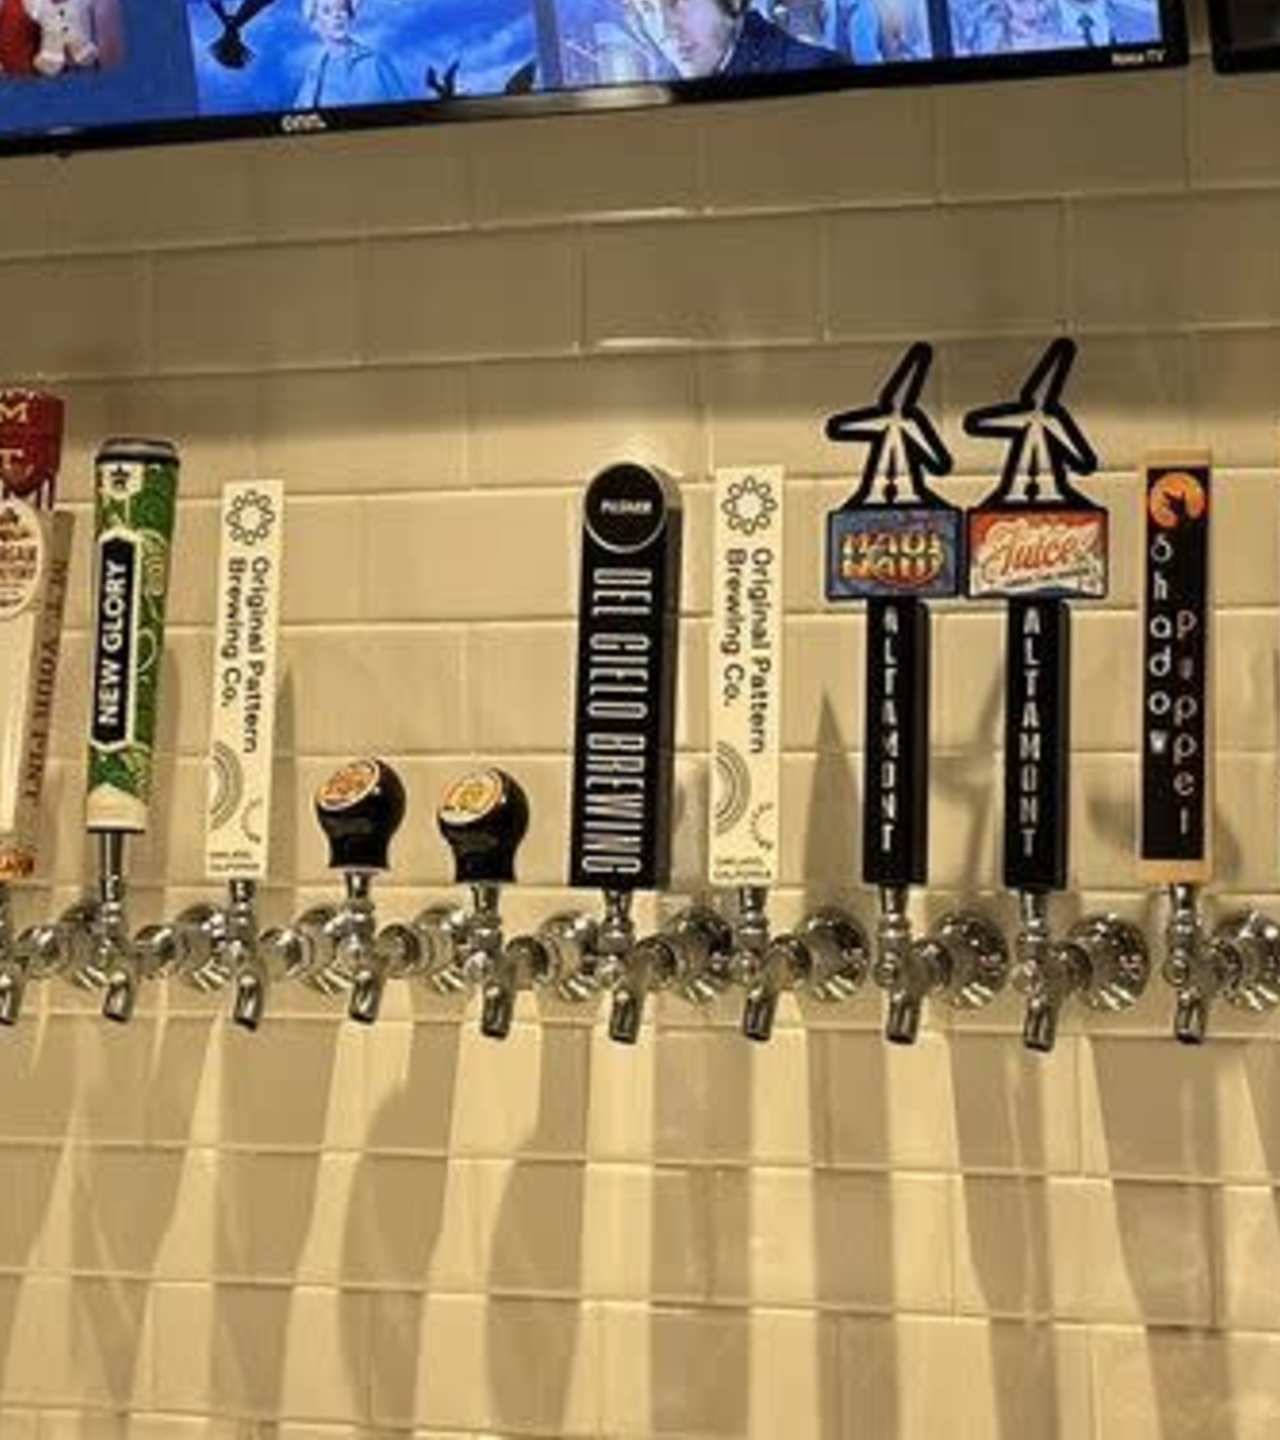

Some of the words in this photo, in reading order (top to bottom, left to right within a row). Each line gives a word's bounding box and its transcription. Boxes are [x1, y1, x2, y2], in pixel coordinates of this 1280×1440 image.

[102, 560, 127, 652] GLORY
[220, 558, 247, 658] Brewing
[244, 556, 271, 652] Original
[592, 567, 654, 618] DEL
[720, 548, 748, 658] Brewing
[747, 547, 774, 651] Original
[97, 660, 123, 725] NEW
[243, 661, 267, 754] Pattern
[586, 633, 651, 720] CIELO
[749, 659, 772, 756] Pattern
[880, 606, 901, 853] ALTAMONT
[1020, 606, 1042, 858] ALTAMONT
[581, 732, 647, 875] BREWING
